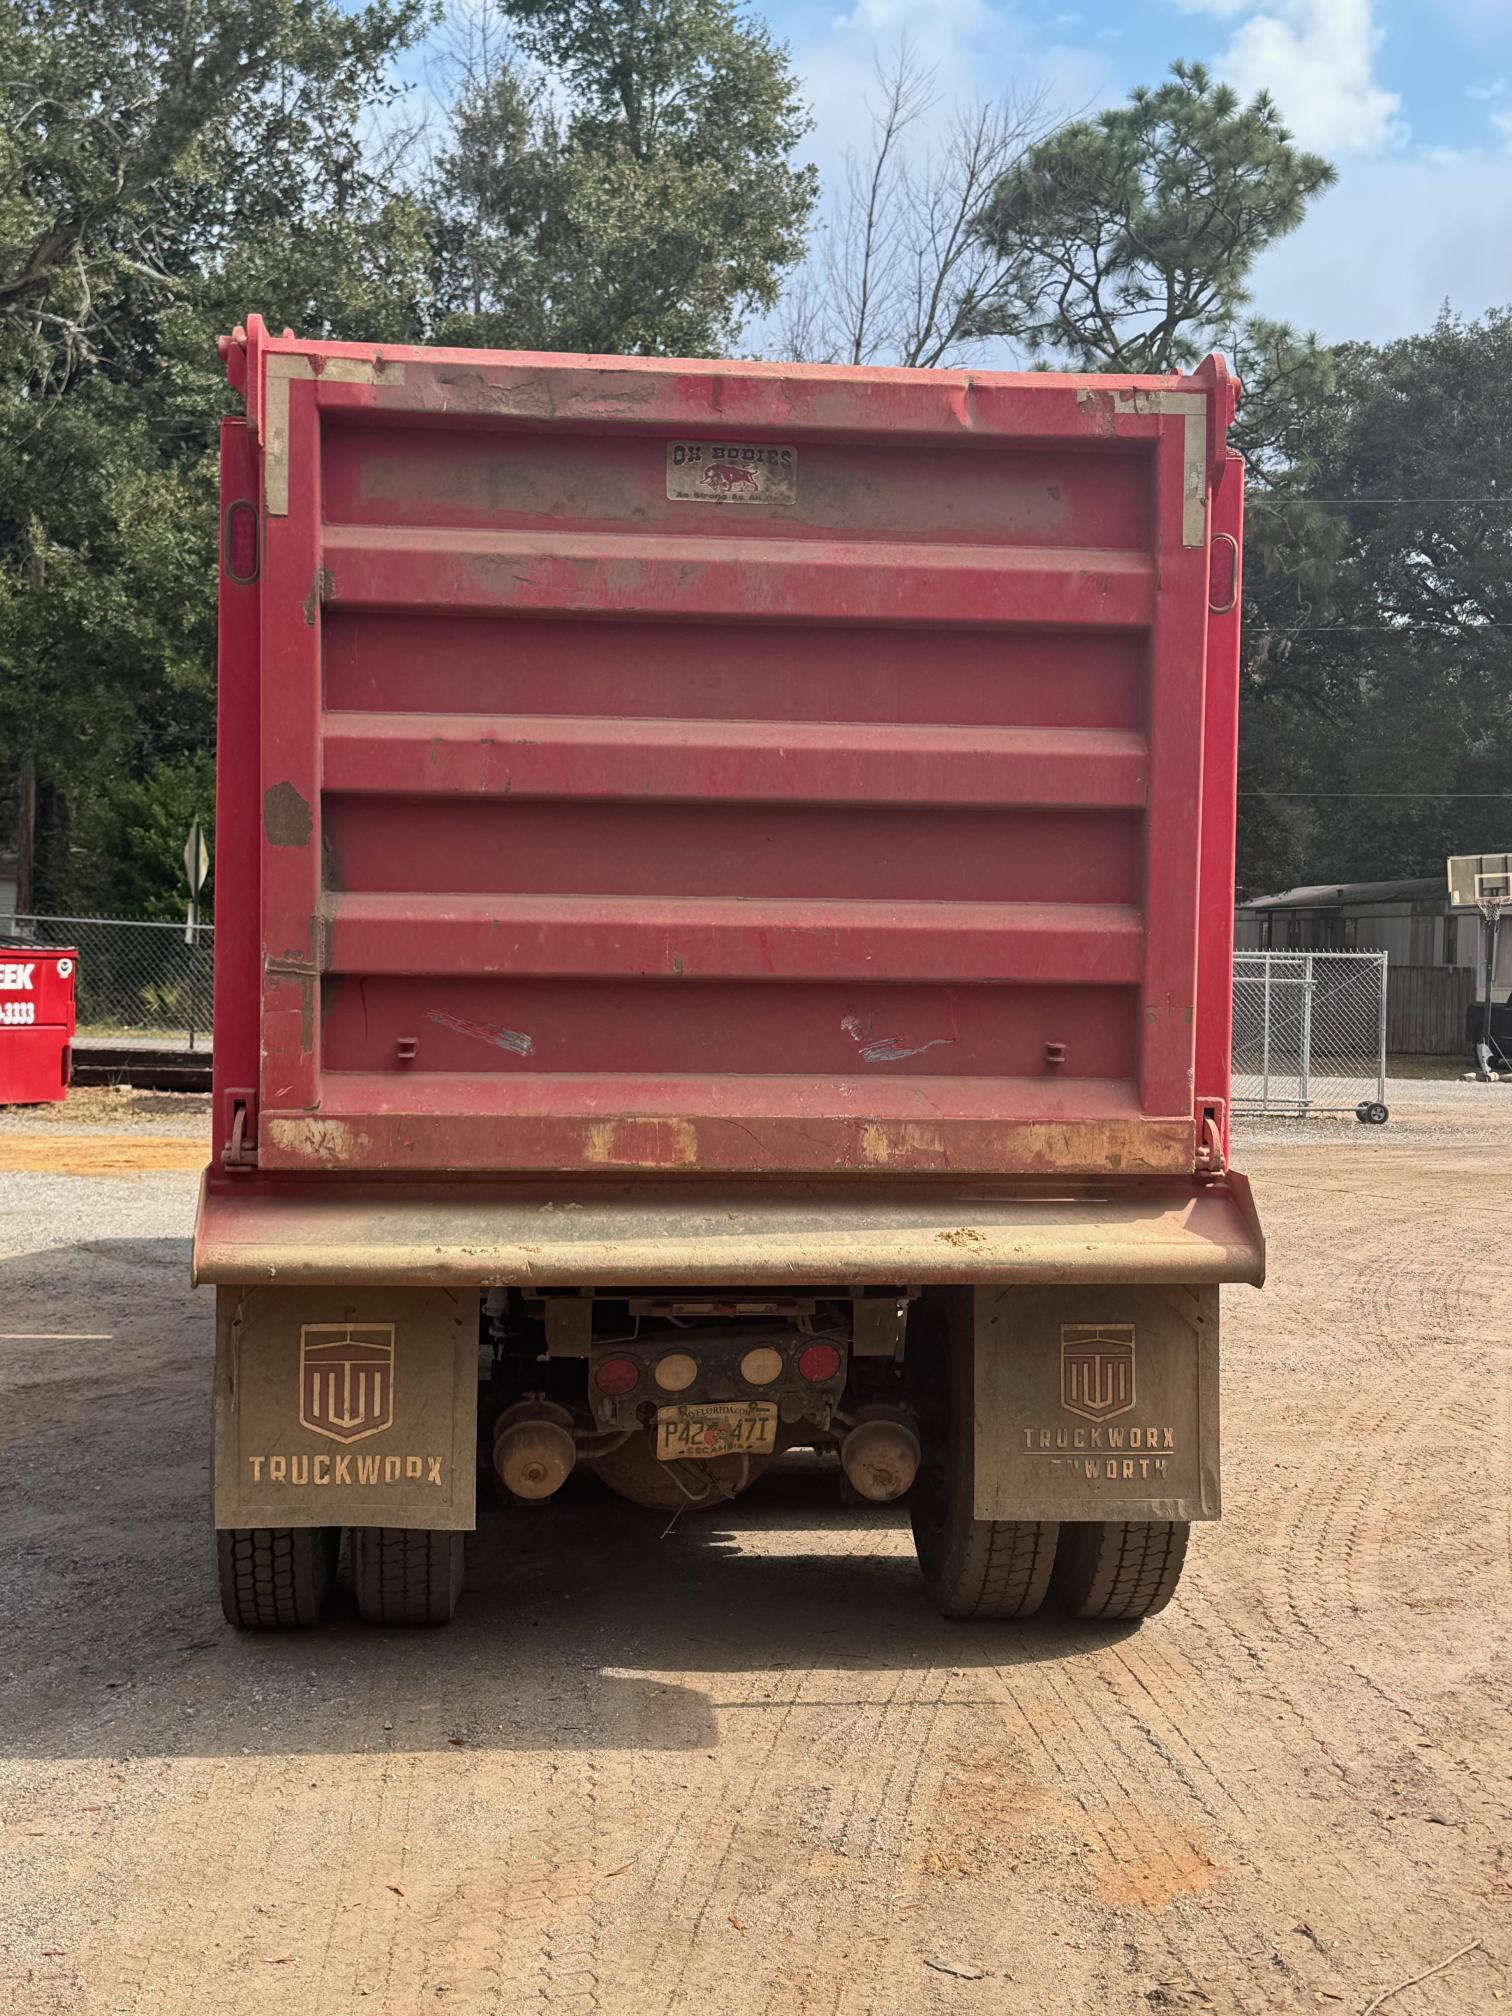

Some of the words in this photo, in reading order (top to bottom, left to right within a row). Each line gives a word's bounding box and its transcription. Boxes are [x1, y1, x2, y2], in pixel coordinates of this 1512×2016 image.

[711, 447, 792, 468] BODIES
[693, 491, 727, 501] Strong
[664, 1421, 704, 1448] P42
[1023, 1427, 1175, 1448] TRUCKWORX
[687, 1443, 744, 1455] ESCAMBIA
